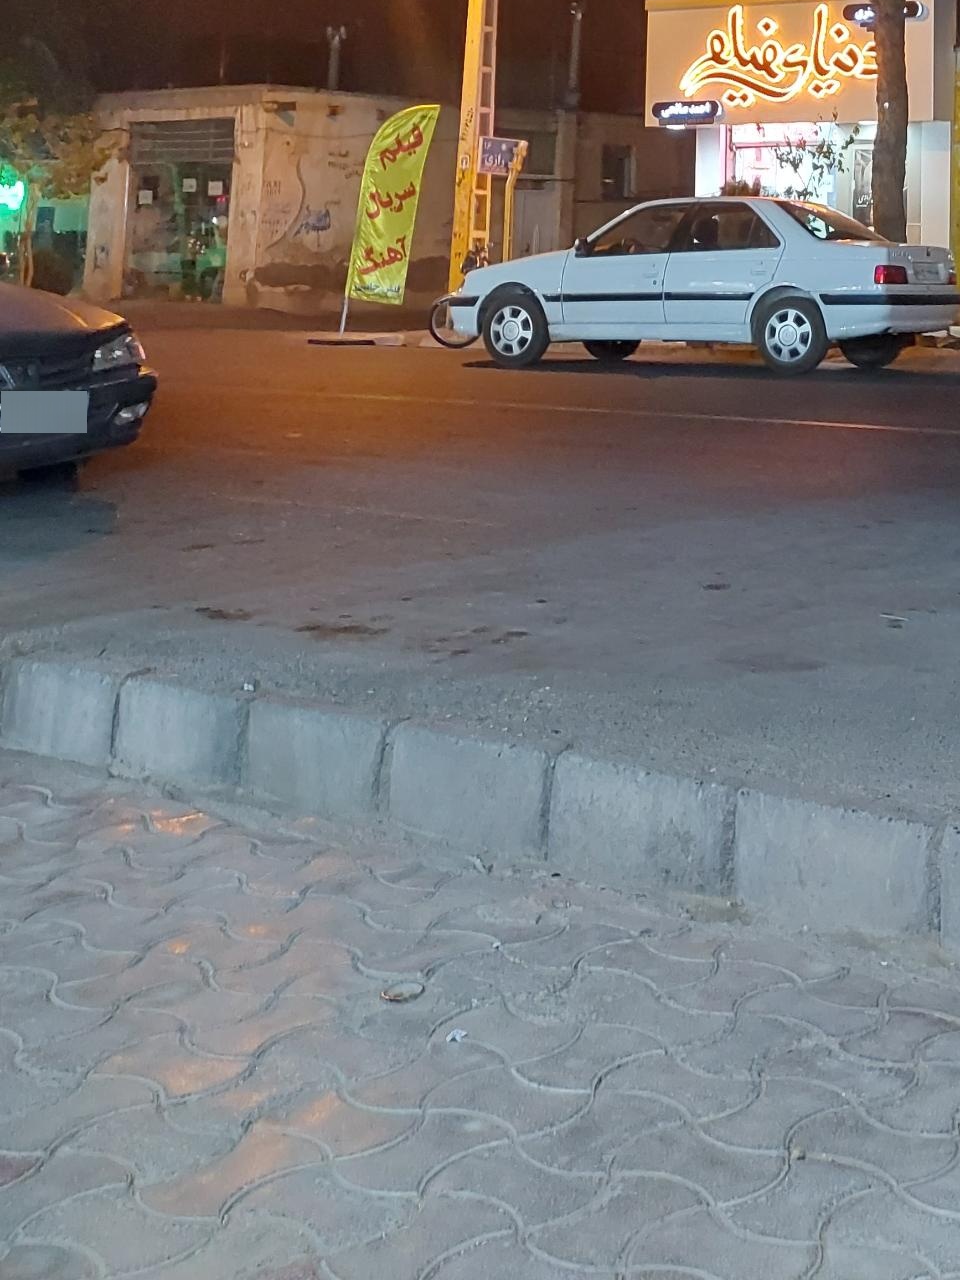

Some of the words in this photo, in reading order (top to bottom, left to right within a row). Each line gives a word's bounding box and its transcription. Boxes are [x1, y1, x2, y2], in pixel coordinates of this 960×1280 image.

[379, 123, 424, 171] فیلم
[365, 181, 417, 220] سریال
[357, 235, 407, 275] آهنگ
